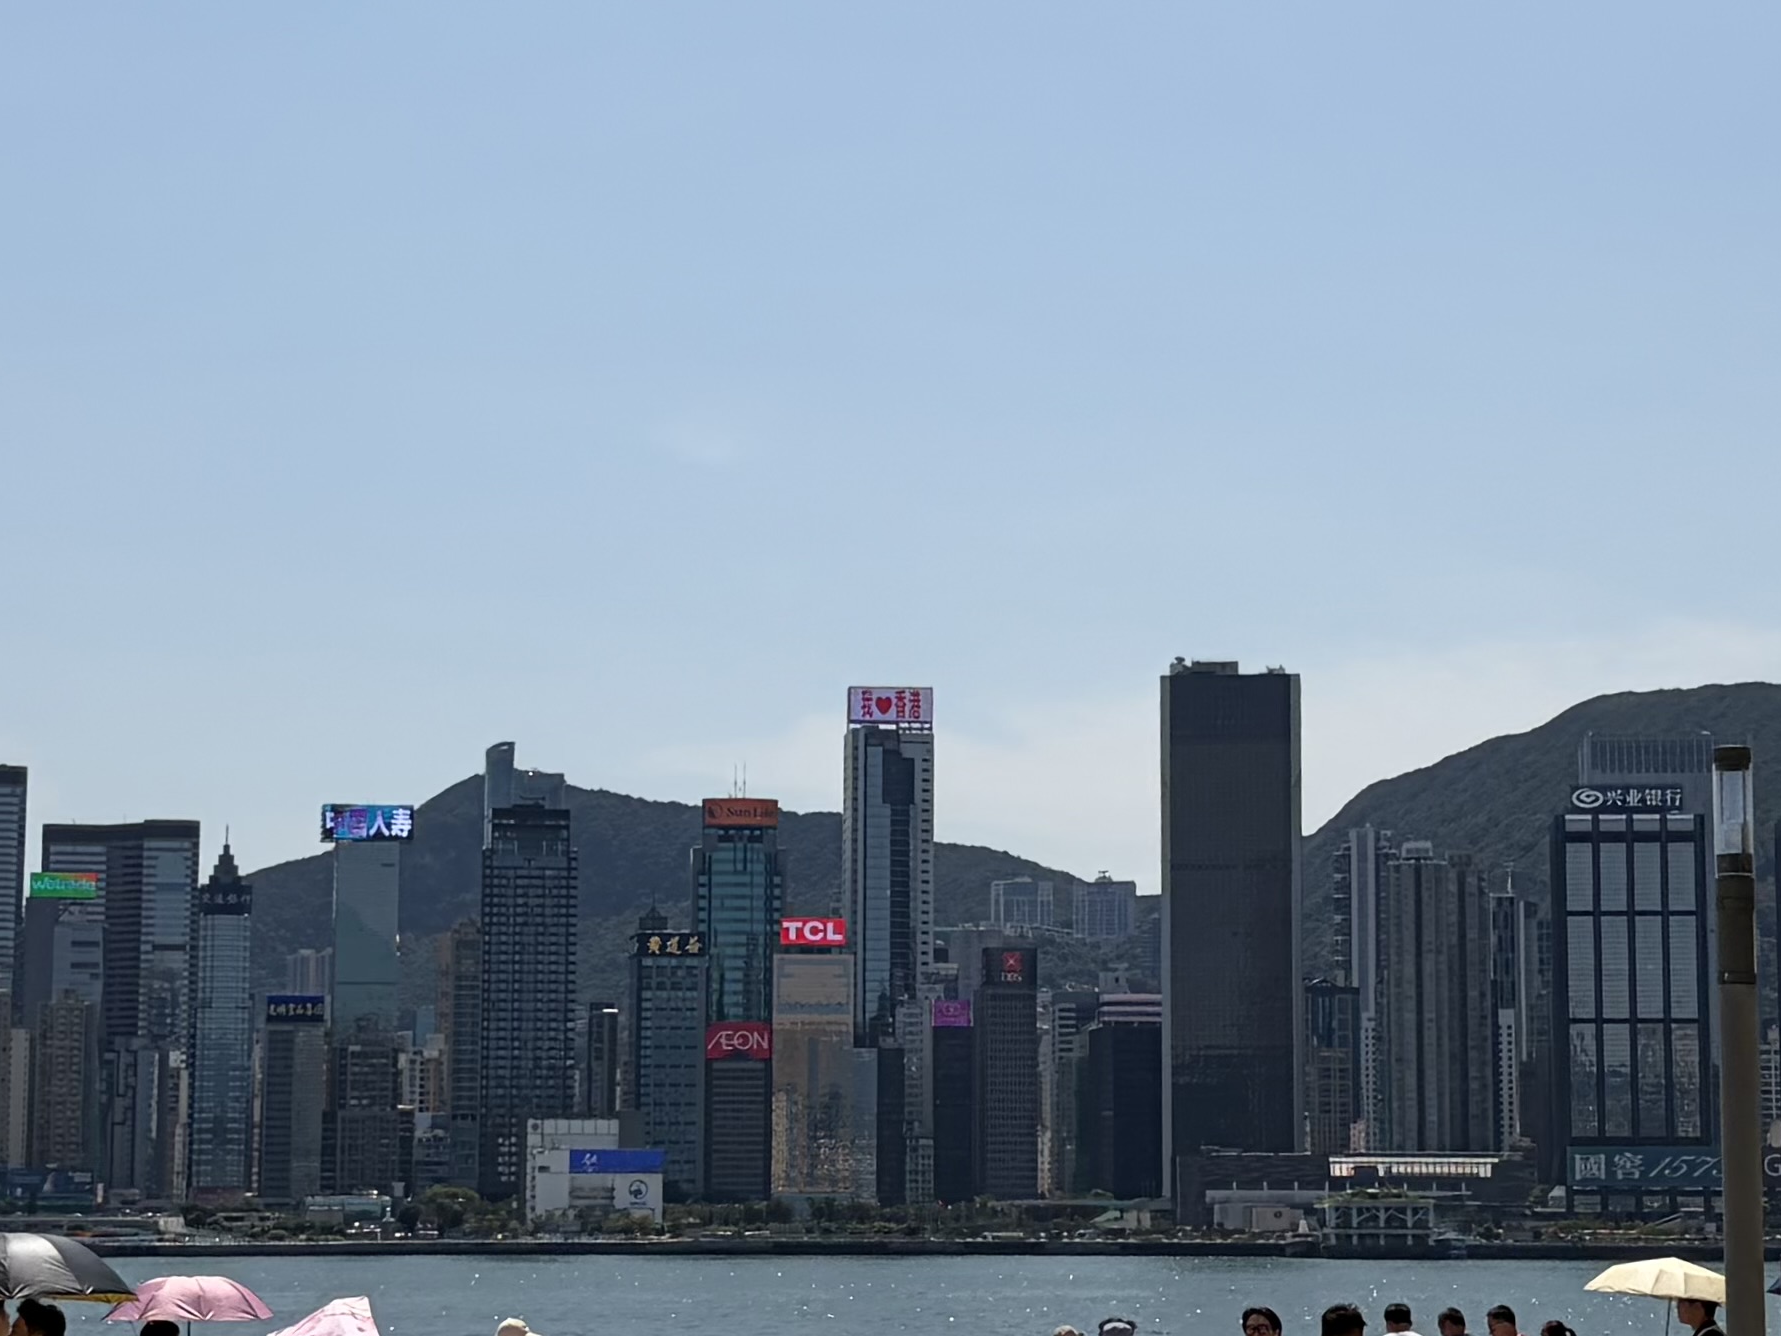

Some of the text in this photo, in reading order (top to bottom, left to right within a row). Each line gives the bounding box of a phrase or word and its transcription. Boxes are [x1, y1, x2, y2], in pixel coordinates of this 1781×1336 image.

[895, 689, 921, 719] 香港
[1605, 789, 1681, 806] 兴业银行
[782, 921, 843, 941] TCL
